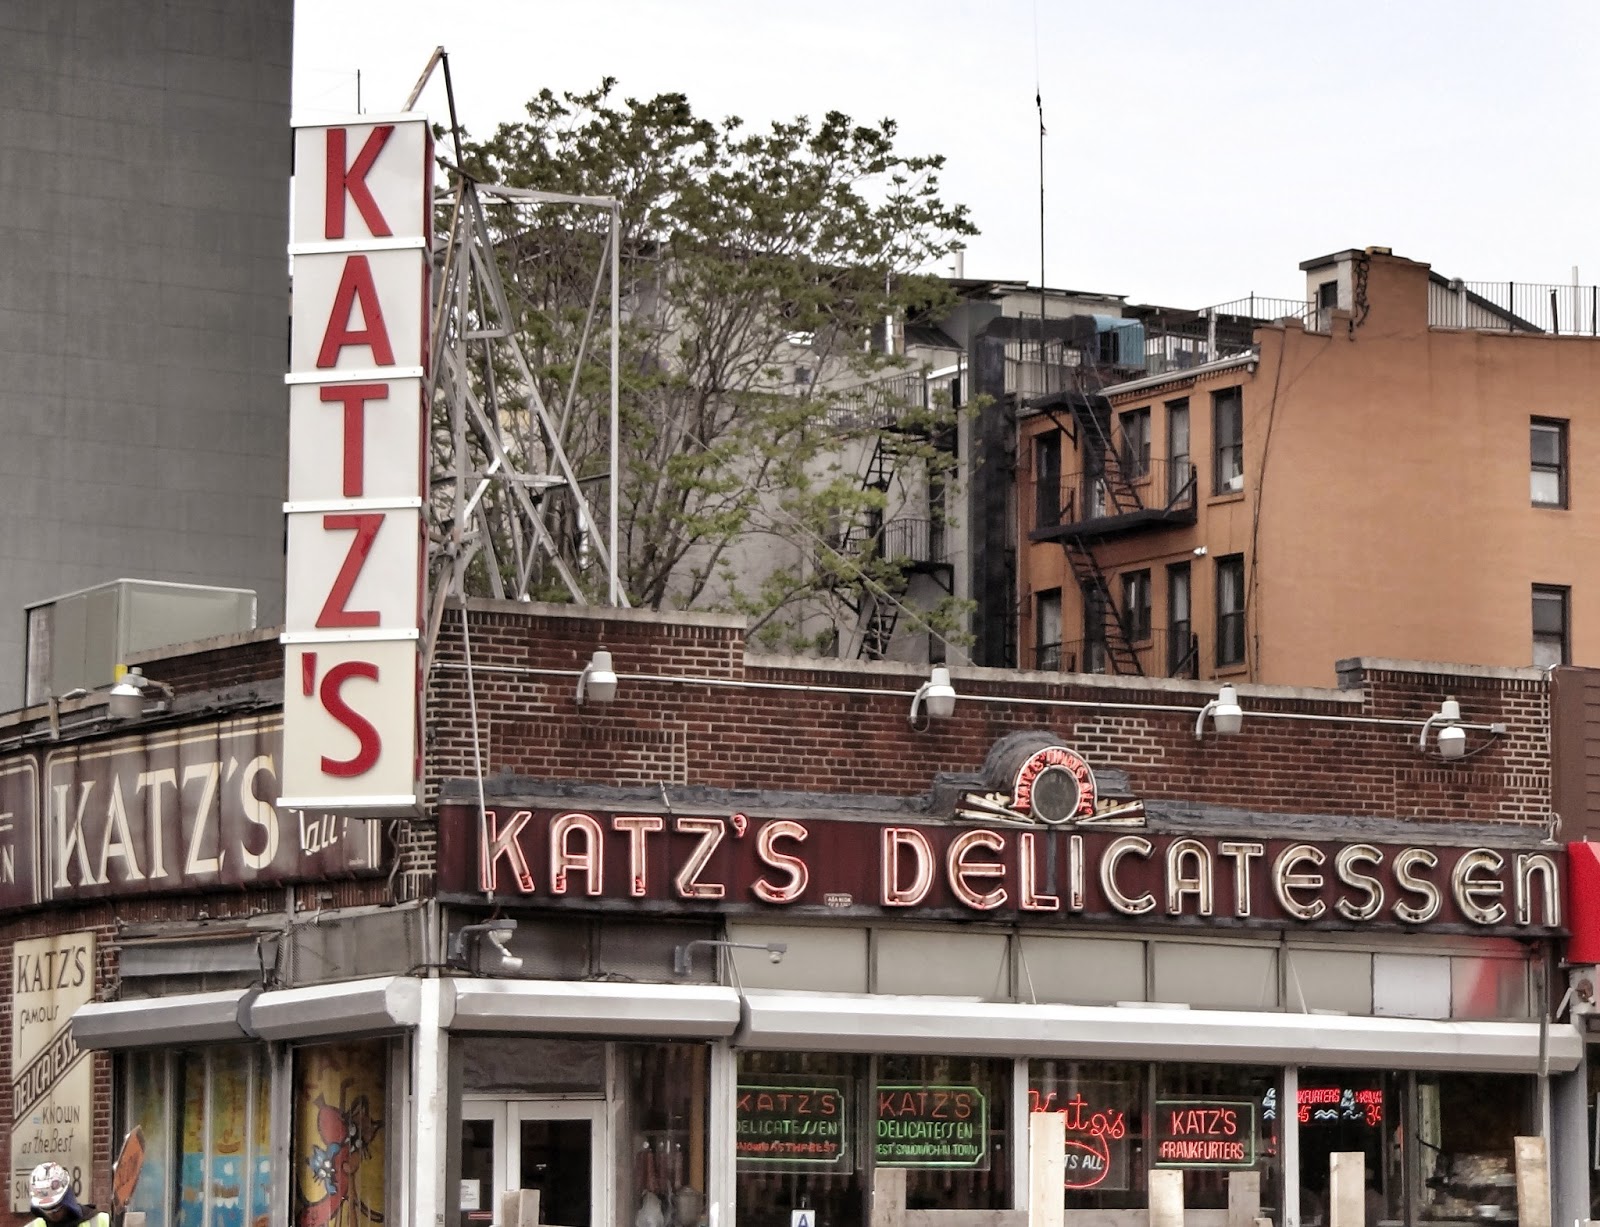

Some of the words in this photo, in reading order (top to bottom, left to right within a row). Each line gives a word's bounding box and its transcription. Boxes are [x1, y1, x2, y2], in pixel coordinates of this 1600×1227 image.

[301, 125, 396, 779] KATZ'S
[53, 754, 281, 889] KATZ'S
[479, 810, 809, 903] KATZ'S
[880, 826, 1562, 927] DELICATESSEN
[17, 946, 87, 993] KATZ'S
[14, 1028, 80, 1119] DELICATESS
[42, 1106, 80, 1124] KNOWN
[737, 1090, 836, 1115] KATZ'S
[879, 1091, 972, 1119] KATZ'S
[877, 1120, 974, 1139] DELICATESSEN
[1171, 1107, 1237, 1136] KATZ'S
[22, 1141, 32, 1154] as
[33, 1130, 50, 1153] the
[50, 1128, 75, 1153] Best
[877, 1143, 893, 1155] EST
[1161, 1141, 1245, 1160] FRANKFURTERS
[1082, 1154, 1103, 1171] ALL
[15, 1180, 30, 1199] SIN
